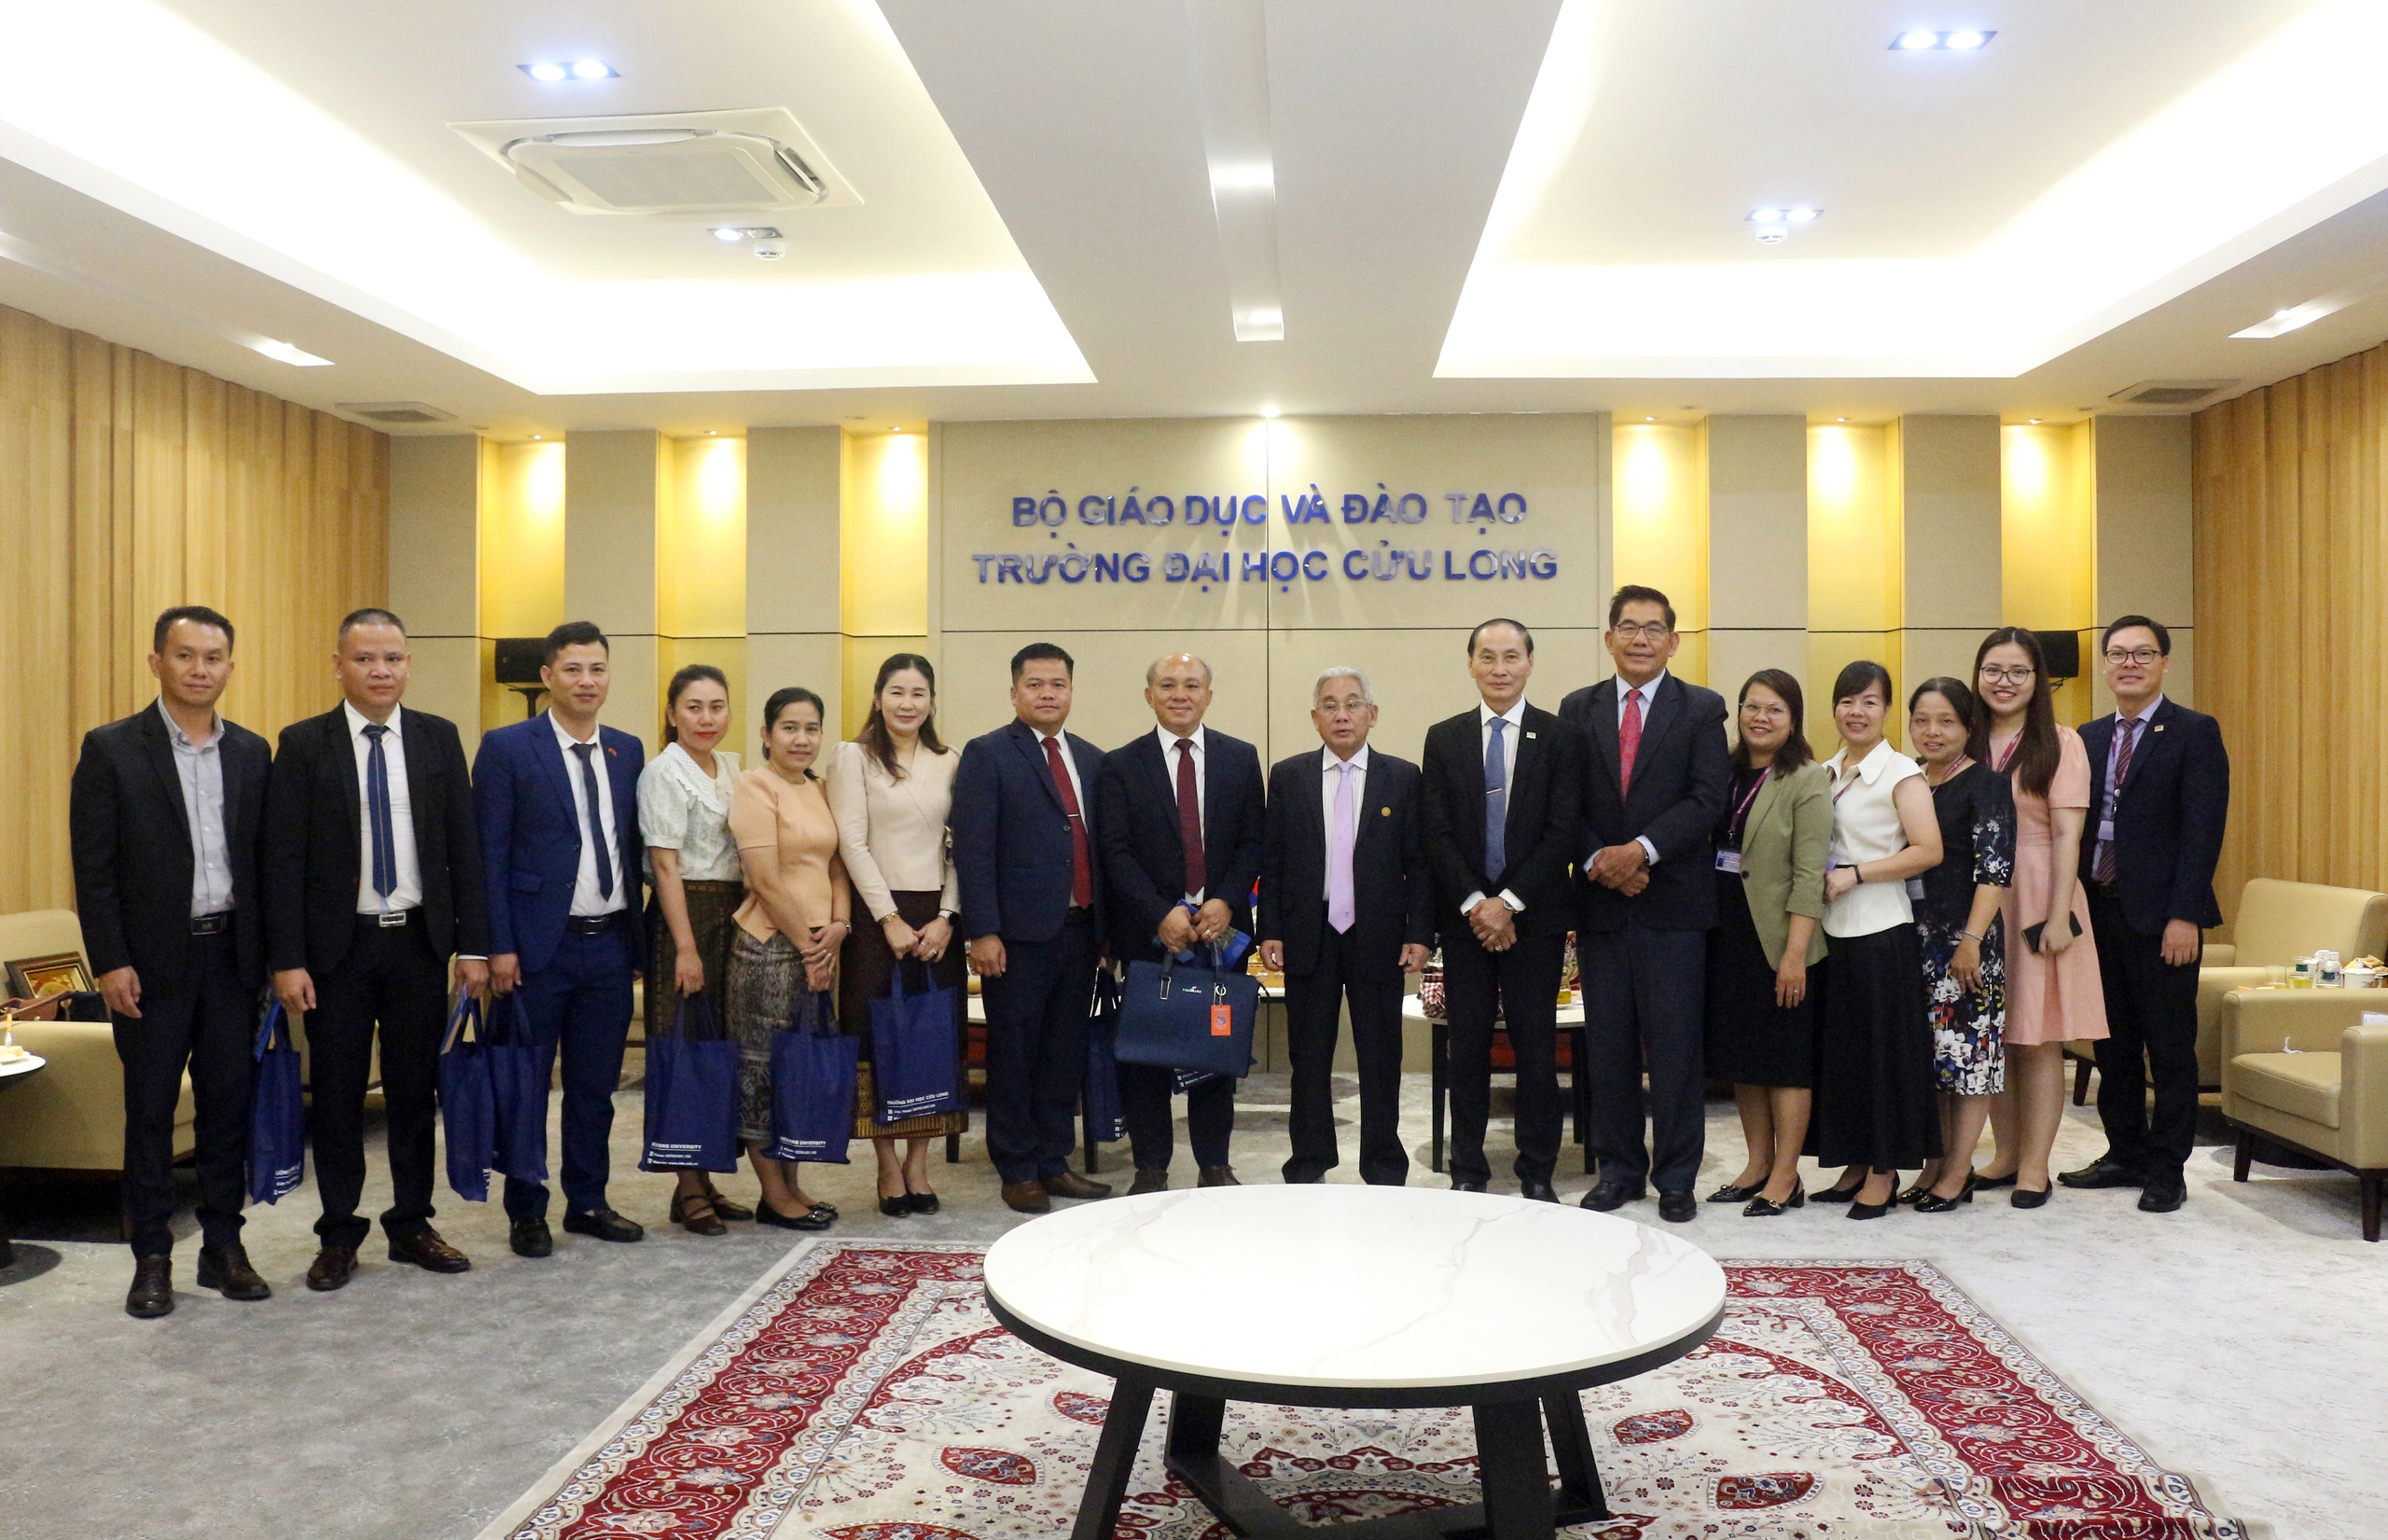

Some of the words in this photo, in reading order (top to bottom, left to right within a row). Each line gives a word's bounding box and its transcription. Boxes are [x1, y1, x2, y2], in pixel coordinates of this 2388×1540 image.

[1012, 489, 1067, 538] BỘ
[1077, 486, 1175, 526] GIÁO
[1185, 494, 1267, 537] DỤC
[1281, 483, 1331, 524] VÀ
[1340, 482, 1428, 524] ĐÀO
[1444, 493, 1528, 535] TẠO
[971, 542, 1152, 585] TRƯỜNG
[1163, 551, 1230, 593] ĐẠI
[1243, 550, 1328, 593] HỌC
[1342, 539, 1434, 581] CỬU
[1444, 548, 1558, 581] LONG
